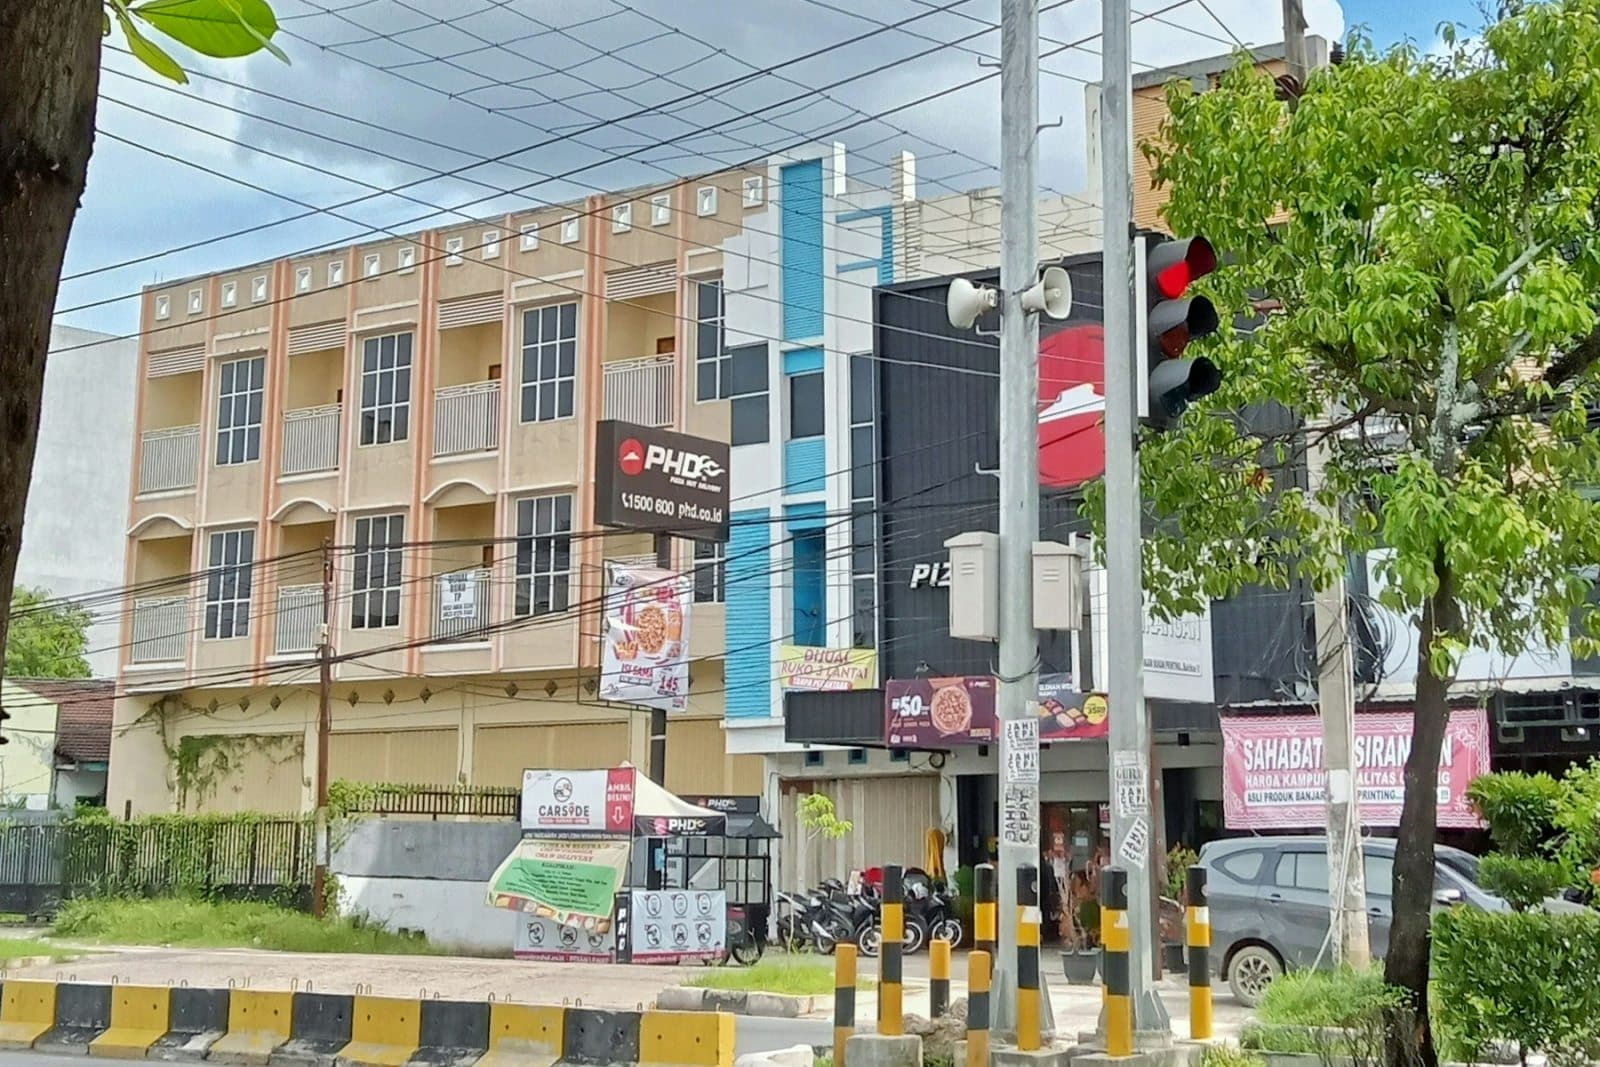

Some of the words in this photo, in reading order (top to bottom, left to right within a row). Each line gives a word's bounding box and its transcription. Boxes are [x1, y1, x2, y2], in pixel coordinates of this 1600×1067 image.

[644, 444, 702, 478] PHD
[629, 493, 653, 512] 1500
[655, 498, 675, 516] 600
[678, 501, 722, 523] phd.co.id
[910, 562, 950, 589] PIZ
[659, 675, 679, 691] 145
[1244, 737, 1323, 770] SAHABAT
[1247, 774, 1279, 787] HARGA
[1357, 773, 1397, 785] ALITAS
[1264, 791, 1293, 802] PRODUK
[668, 818, 698, 831] PHD
